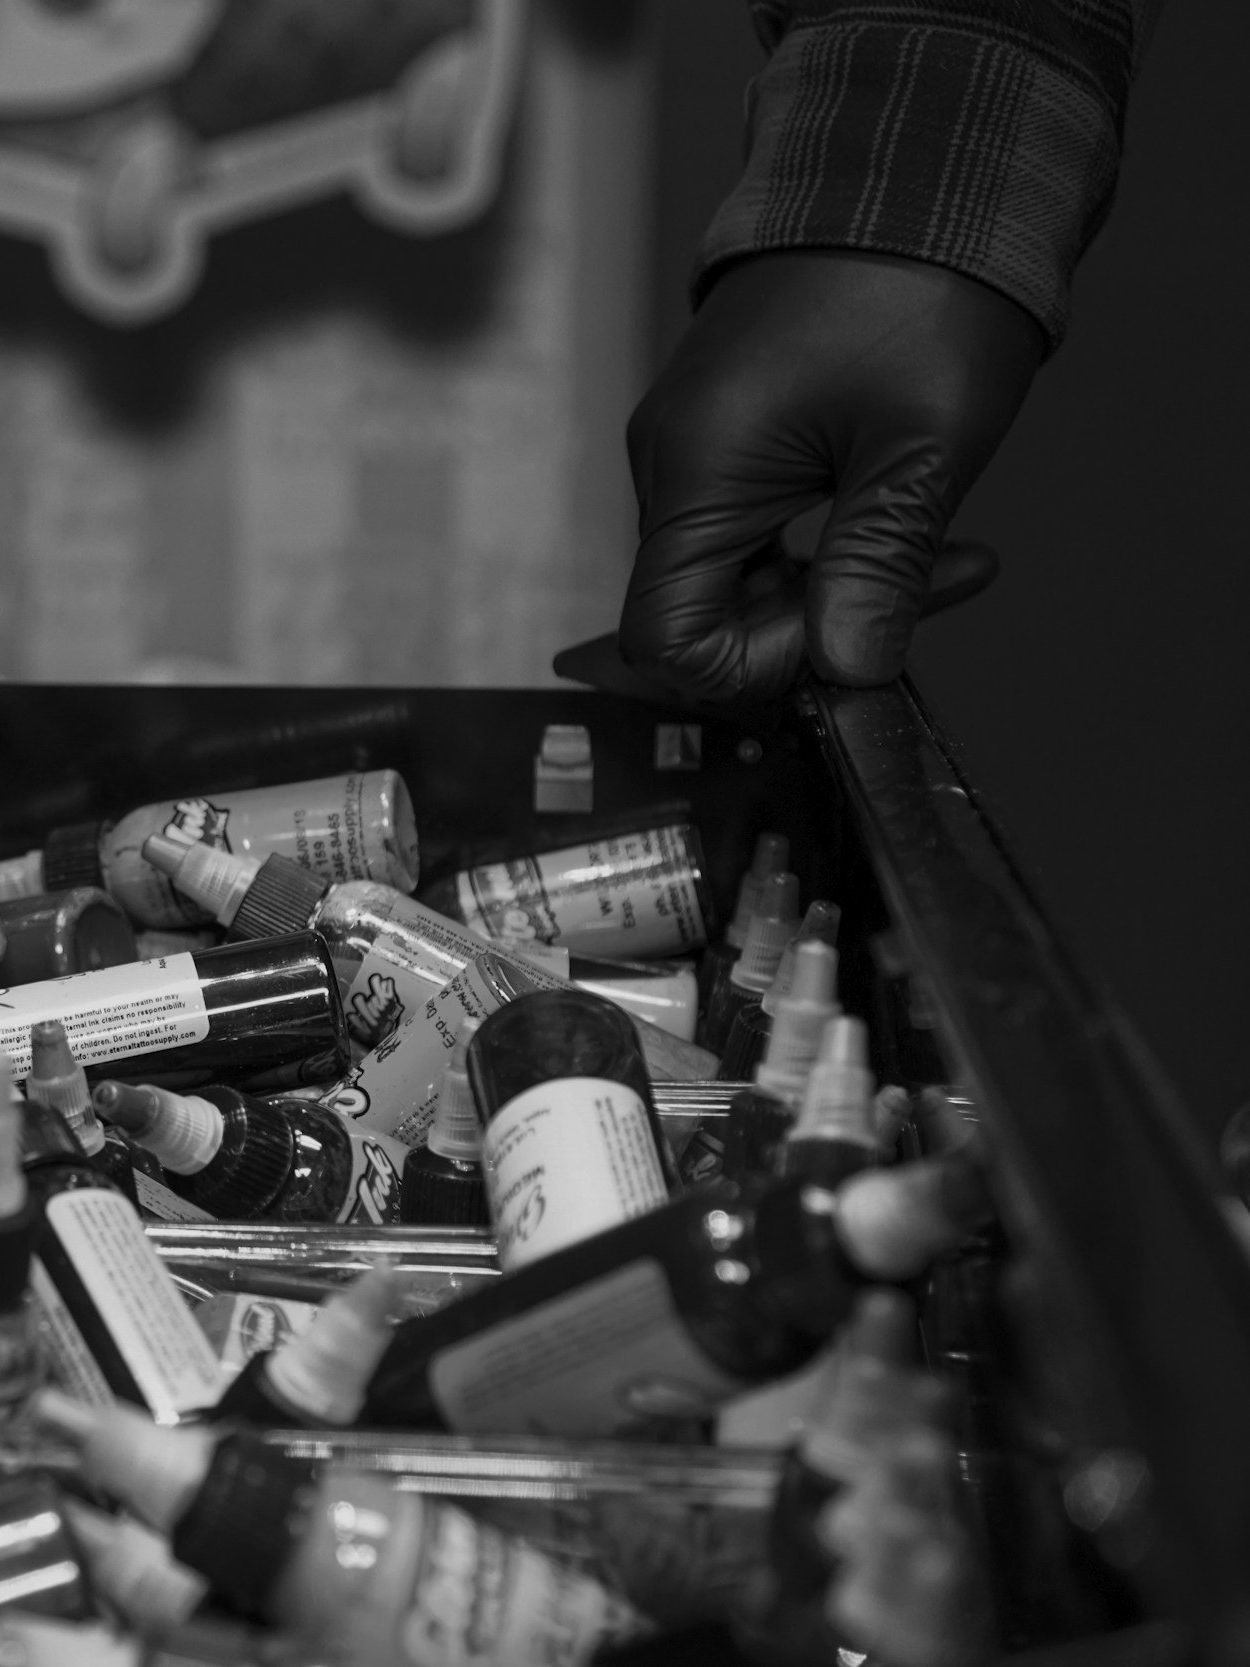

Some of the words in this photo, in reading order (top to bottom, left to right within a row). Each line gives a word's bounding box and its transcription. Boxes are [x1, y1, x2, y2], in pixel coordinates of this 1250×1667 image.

[0, 1025, 16, 1034] This
[63, 1013, 73, 1021] be
[73, 1007, 102, 1020] harmful
[112, 1003, 129, 1013] your
[130, 997, 153, 1008] health
[163, 992, 180, 1002] may
[0, 1033, 27, 1046] allergic
[87, 1018, 100, 1026] Ink
[101, 1012, 124, 1024] claims
[125, 1011, 135, 1019] no
[136, 1000, 186, 1017] responsibility
[433, 1014, 456, 1050] Exp.
[71, 1042, 79, 1051] of
[79, 1036, 112, 1049] children.
[112, 1034, 123, 1042] Do
[123, 1031, 137, 1040] not
[137, 1025, 163, 1039] ingest.
[163, 1022, 177, 1031] For
